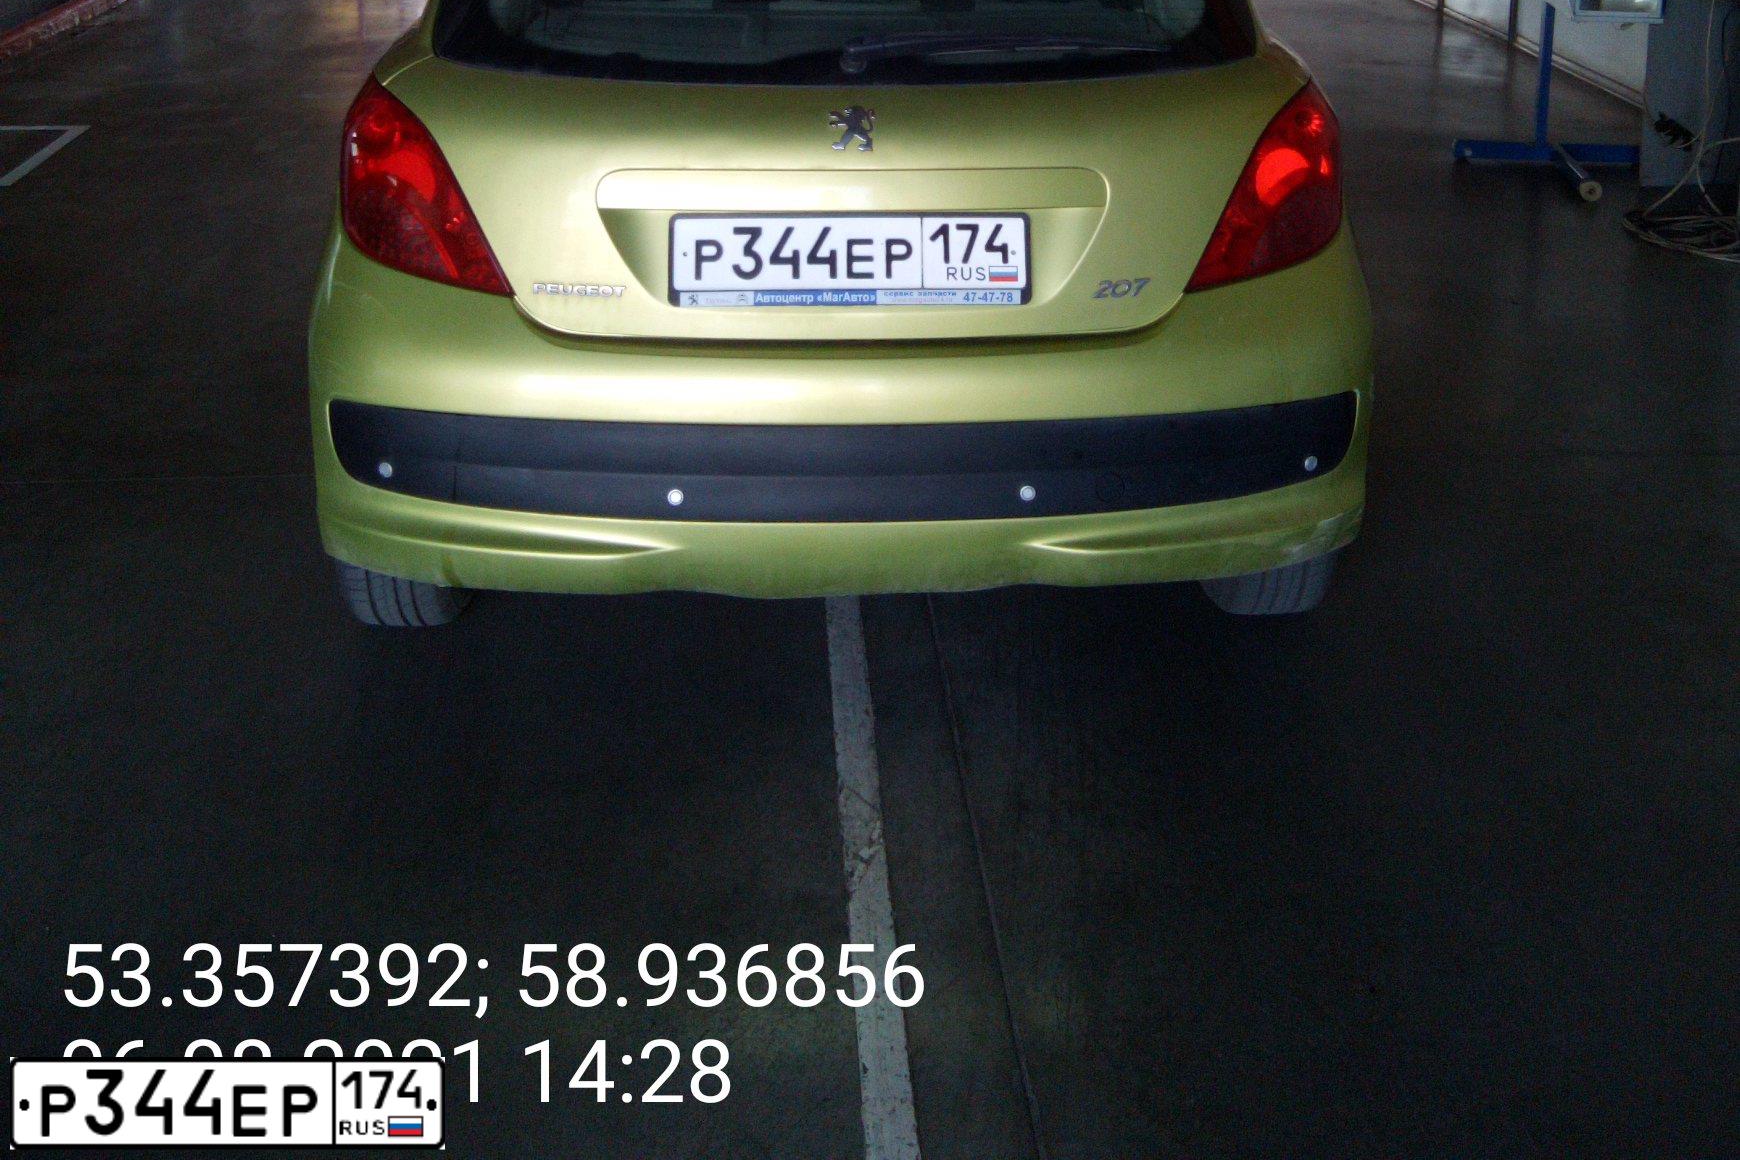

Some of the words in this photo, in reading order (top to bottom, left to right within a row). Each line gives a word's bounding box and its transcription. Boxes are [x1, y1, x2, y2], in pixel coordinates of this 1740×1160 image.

[694, 226, 913, 281] Р344ЕР
[929, 224, 1008, 264] 174
[946, 266, 986, 281] RUS
[532, 283, 626, 297] PEUGEOT
[1092, 278, 1151, 298] 207
[755, 293, 814, 304] Автоцентр
[963, 292, 1014, 304] 47-47-78
